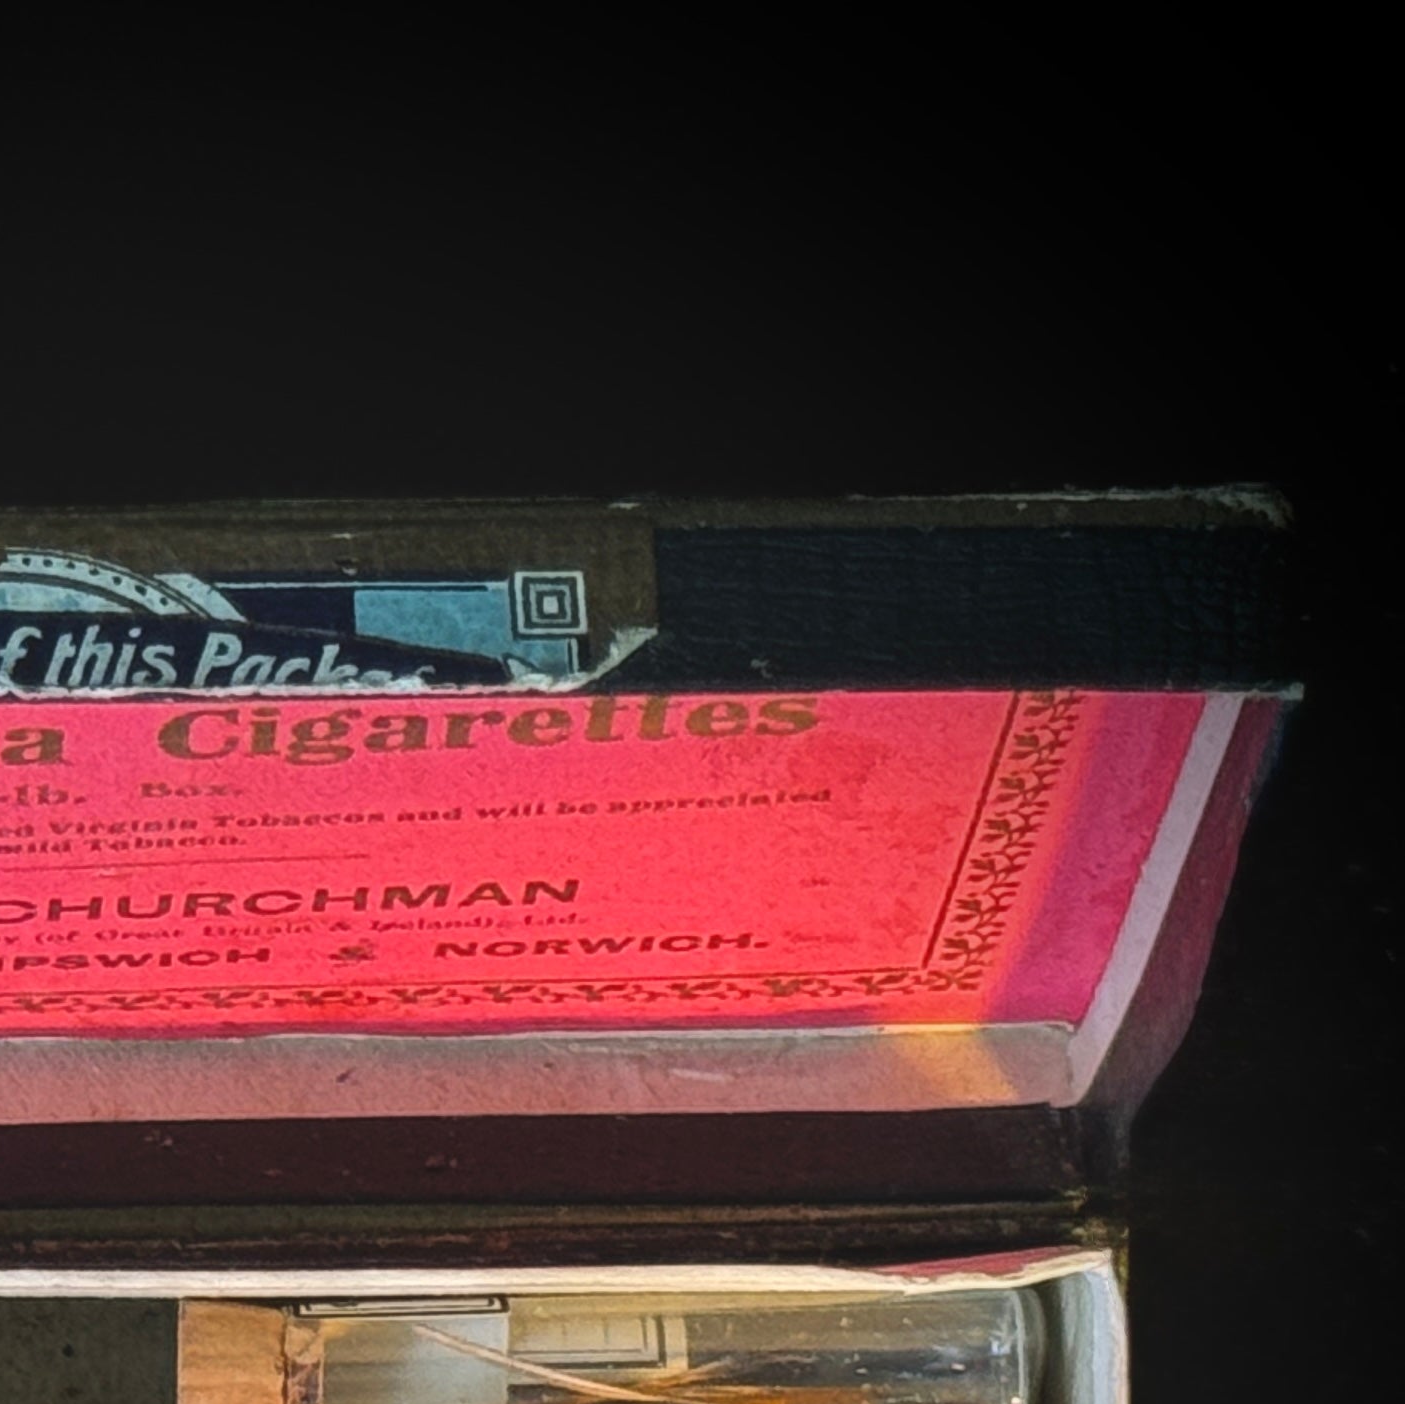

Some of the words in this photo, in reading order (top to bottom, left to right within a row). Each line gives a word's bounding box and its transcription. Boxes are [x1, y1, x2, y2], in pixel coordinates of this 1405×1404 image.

[44, 627, 178, 687] this
[157, 695, 818, 767] Cigarettes
[49, 817, 197, 836] Virginia
[397, 806, 463, 822] and
[475, 803, 547, 819] will
[555, 801, 598, 816] be
[607, 788, 831, 815] appreciated
[434, 932, 770, 959] NORWICH.
